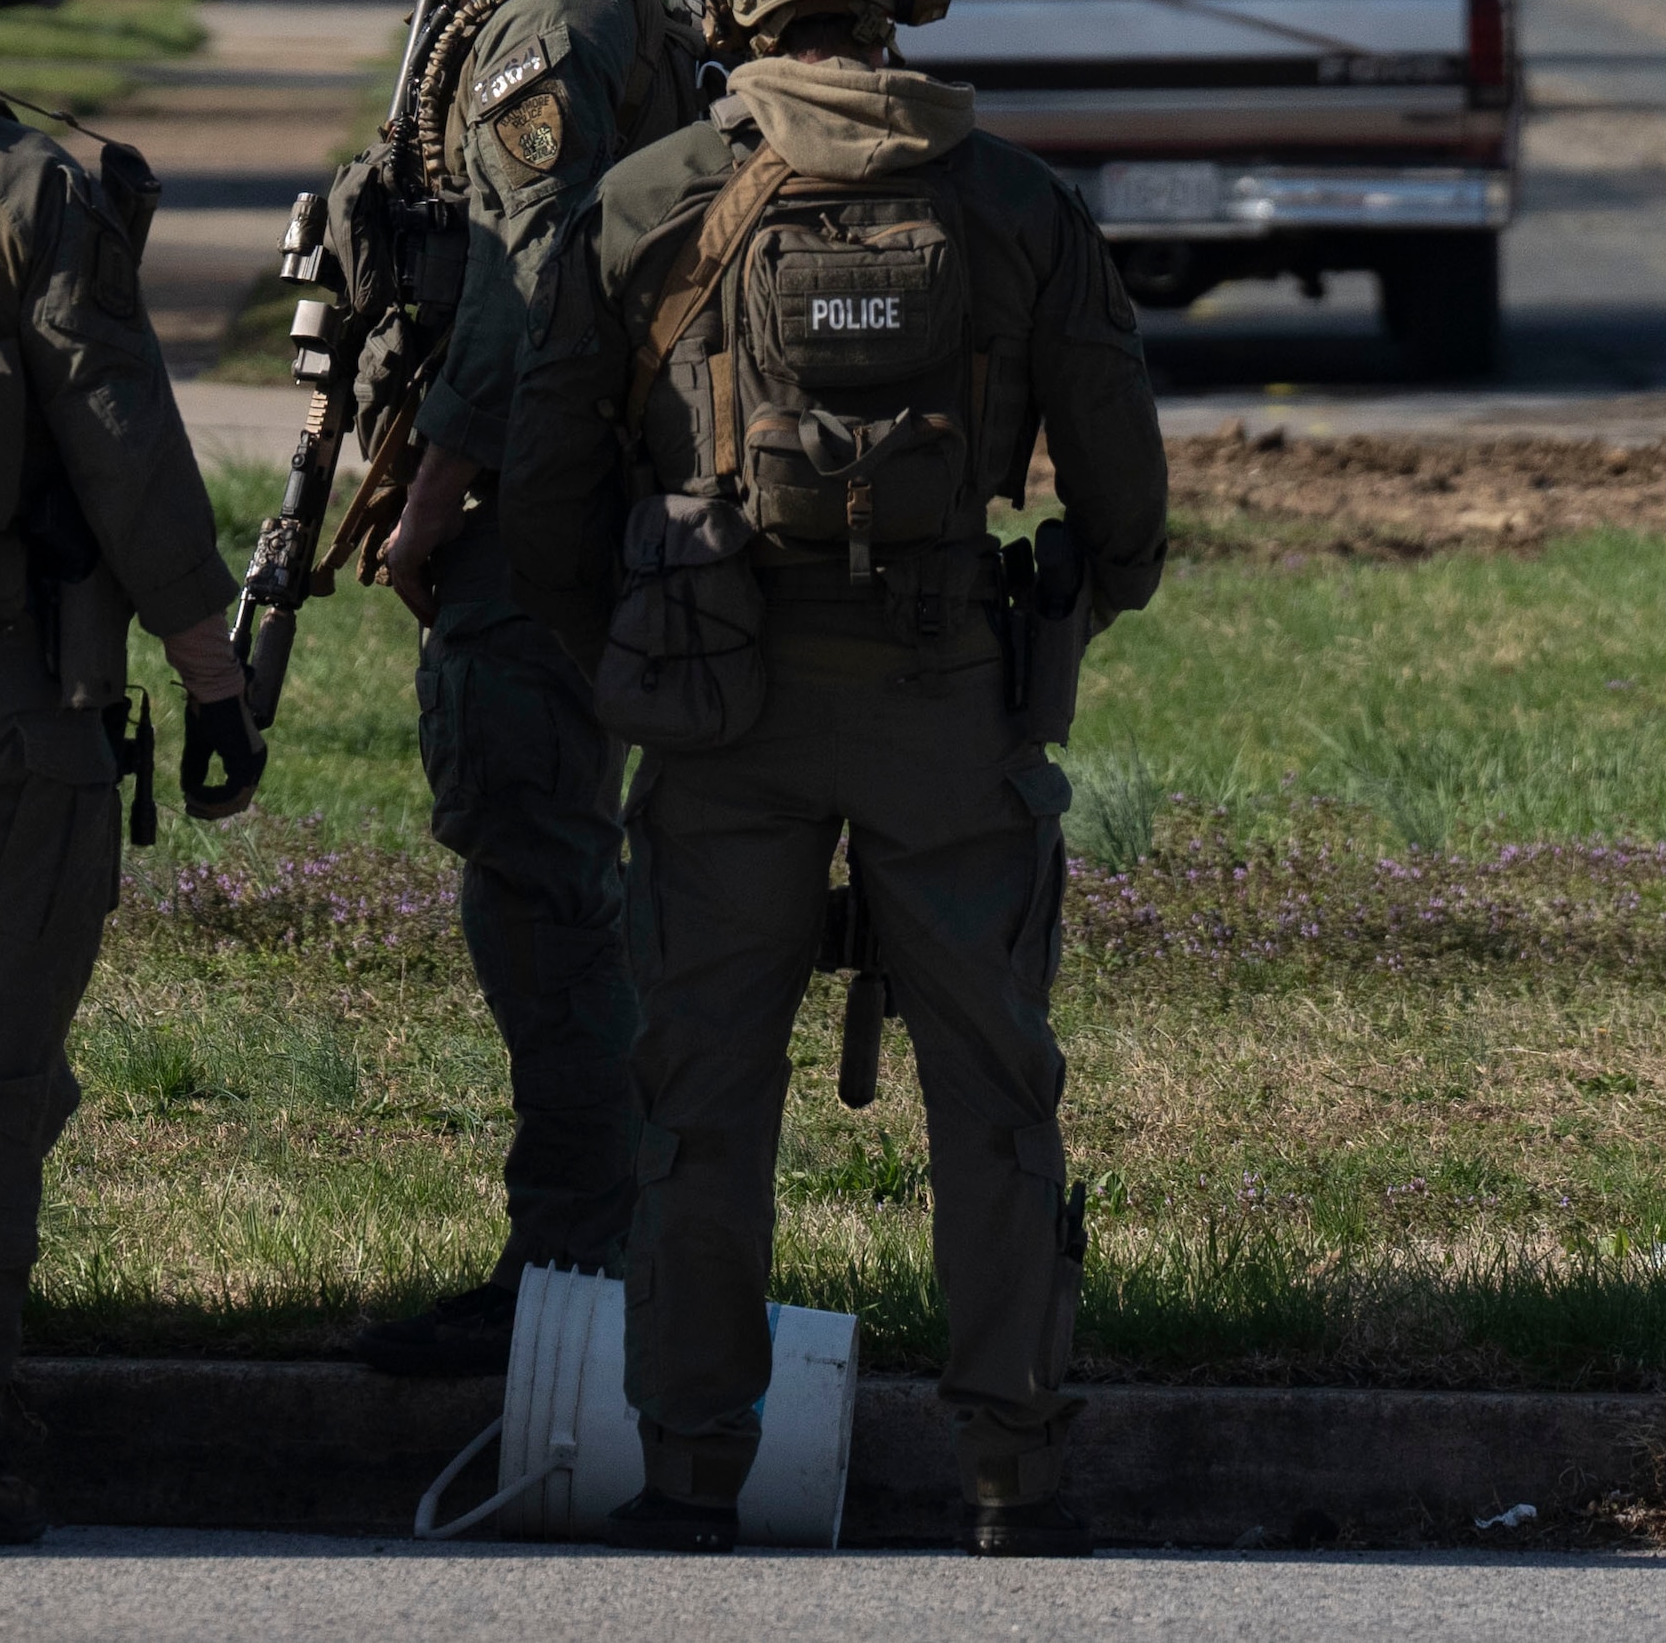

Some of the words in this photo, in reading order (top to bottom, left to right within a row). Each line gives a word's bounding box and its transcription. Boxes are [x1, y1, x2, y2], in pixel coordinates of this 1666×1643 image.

[500, 96, 550, 127] BALTIMORE
[512, 108, 543, 128] POLICE
[812, 297, 900, 330] POLICE
